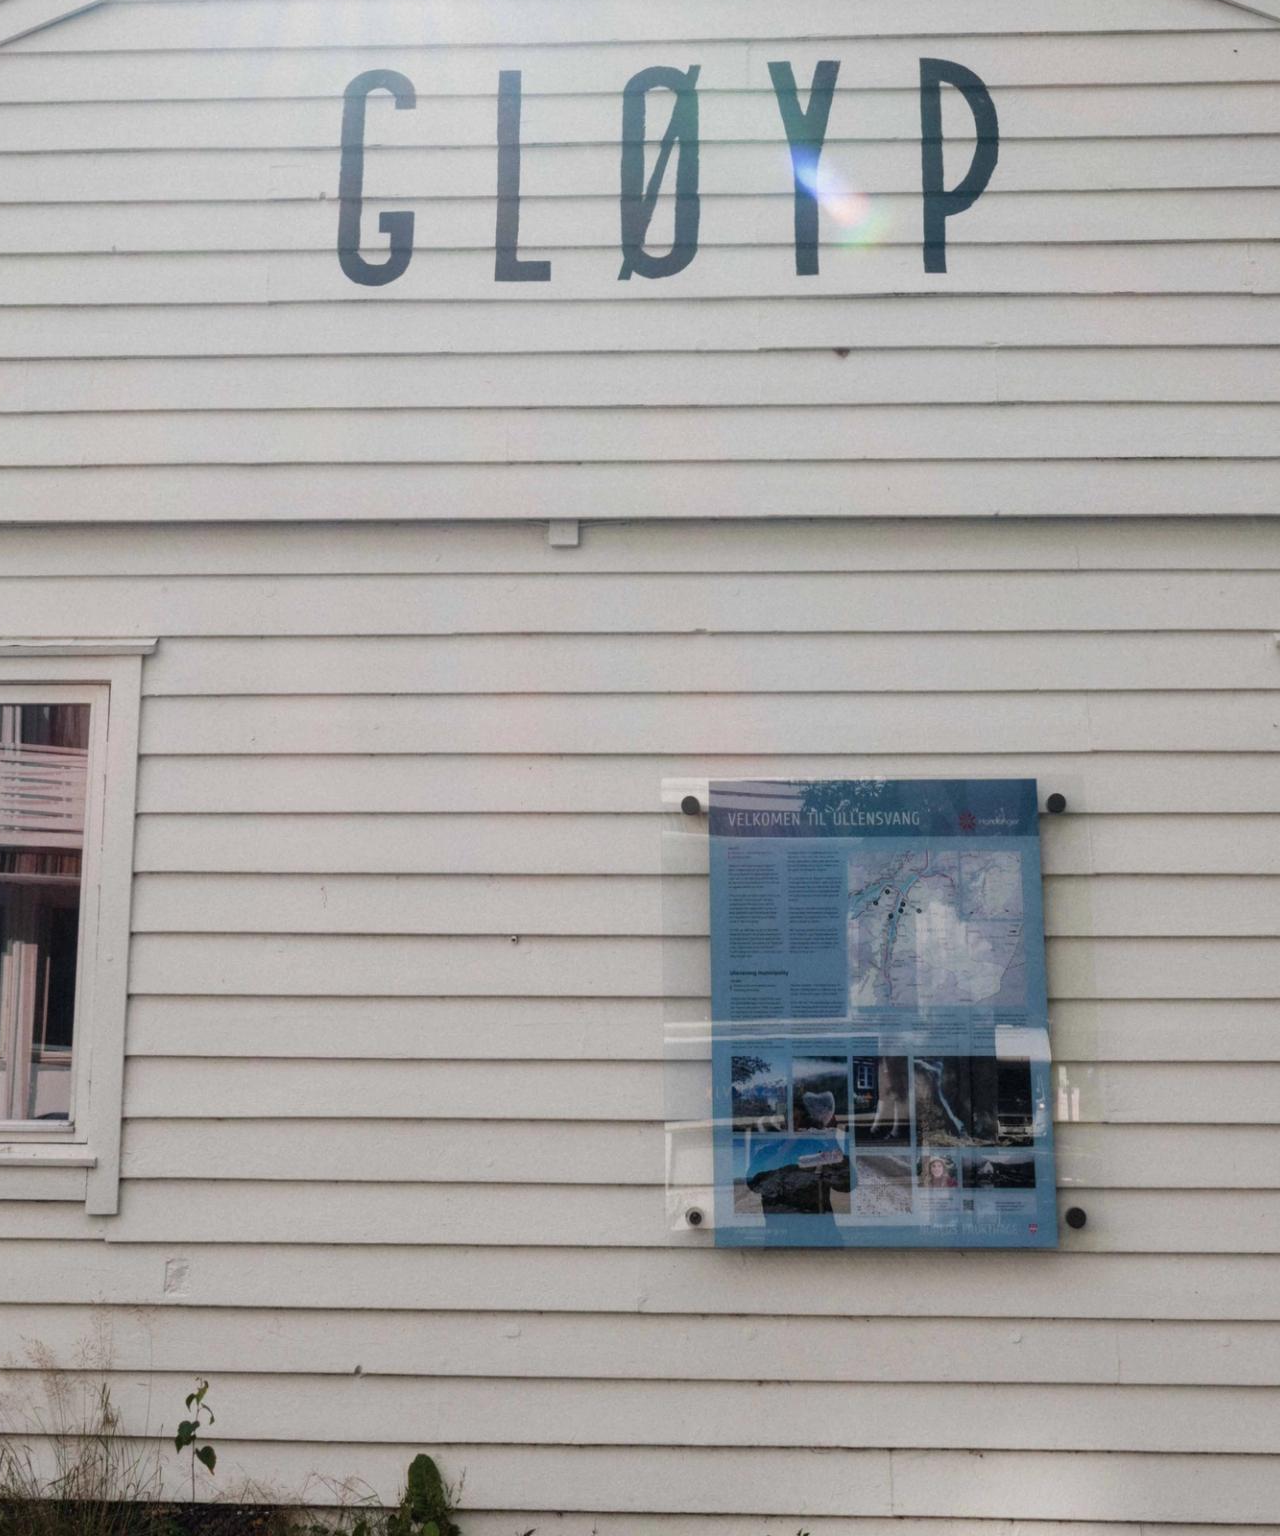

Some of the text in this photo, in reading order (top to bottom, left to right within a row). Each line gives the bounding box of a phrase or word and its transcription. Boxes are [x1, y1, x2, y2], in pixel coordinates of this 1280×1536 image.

[336, 56, 1000, 287] GLØYP
[727, 810, 921, 827] VELKOMEN TIL ULLENSVANG
